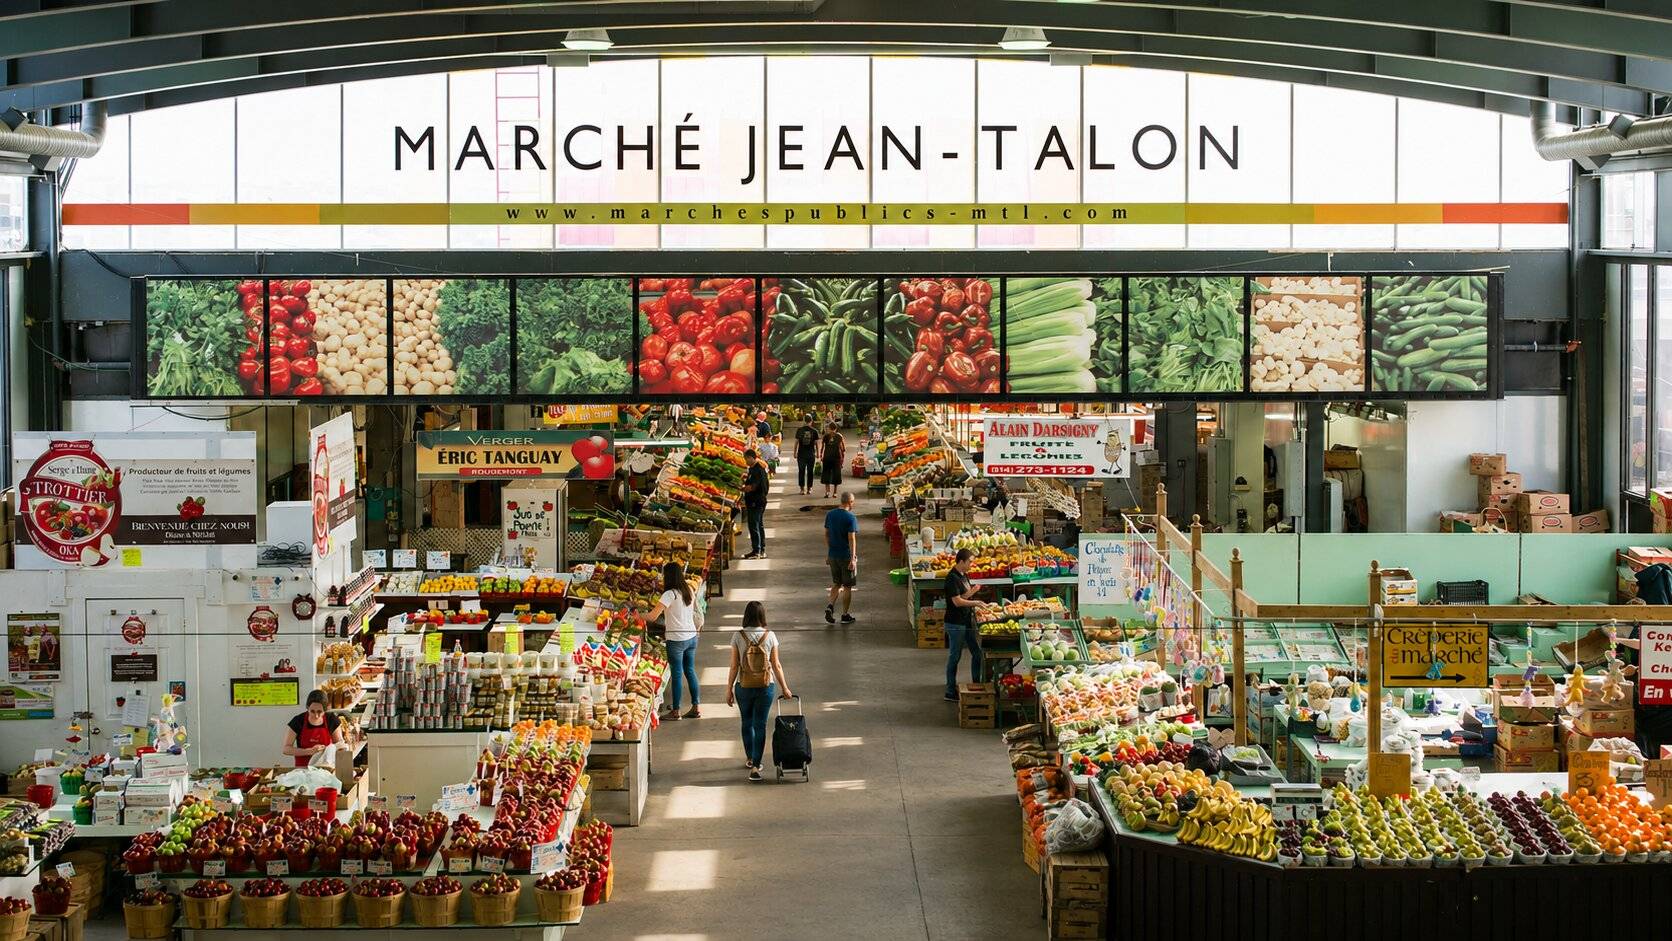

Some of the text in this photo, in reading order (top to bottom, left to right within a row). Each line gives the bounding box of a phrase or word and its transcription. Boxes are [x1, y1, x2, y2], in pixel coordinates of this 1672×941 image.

[394, 112, 1240, 185] MARCHÉ JEAN-TALON
[506, 204, 1128, 224] www.marchespublics-mtl.com
[989, 420, 1099, 438] ALAIN DARSIGNY
[467, 435, 534, 446] VERGER
[438, 448, 562, 465] ÉRIC TANGUAY
[129, 468, 172, 476] Producteur
[187, 467, 207, 475] fruits
[219, 467, 251, 476] légumes
[471, 468, 528, 476] ROUGEMONT
[1015, 466, 1087, 474] 273-1124
[32, 480, 108, 504] TROTTIER
[132, 521, 189, 531] BIENVENUE
[190, 521, 218, 531] CHEZ
[59, 545, 80, 556] OKA
[1651, 664, 1672, 673] Ch
[1643, 684, 1664, 698] En
